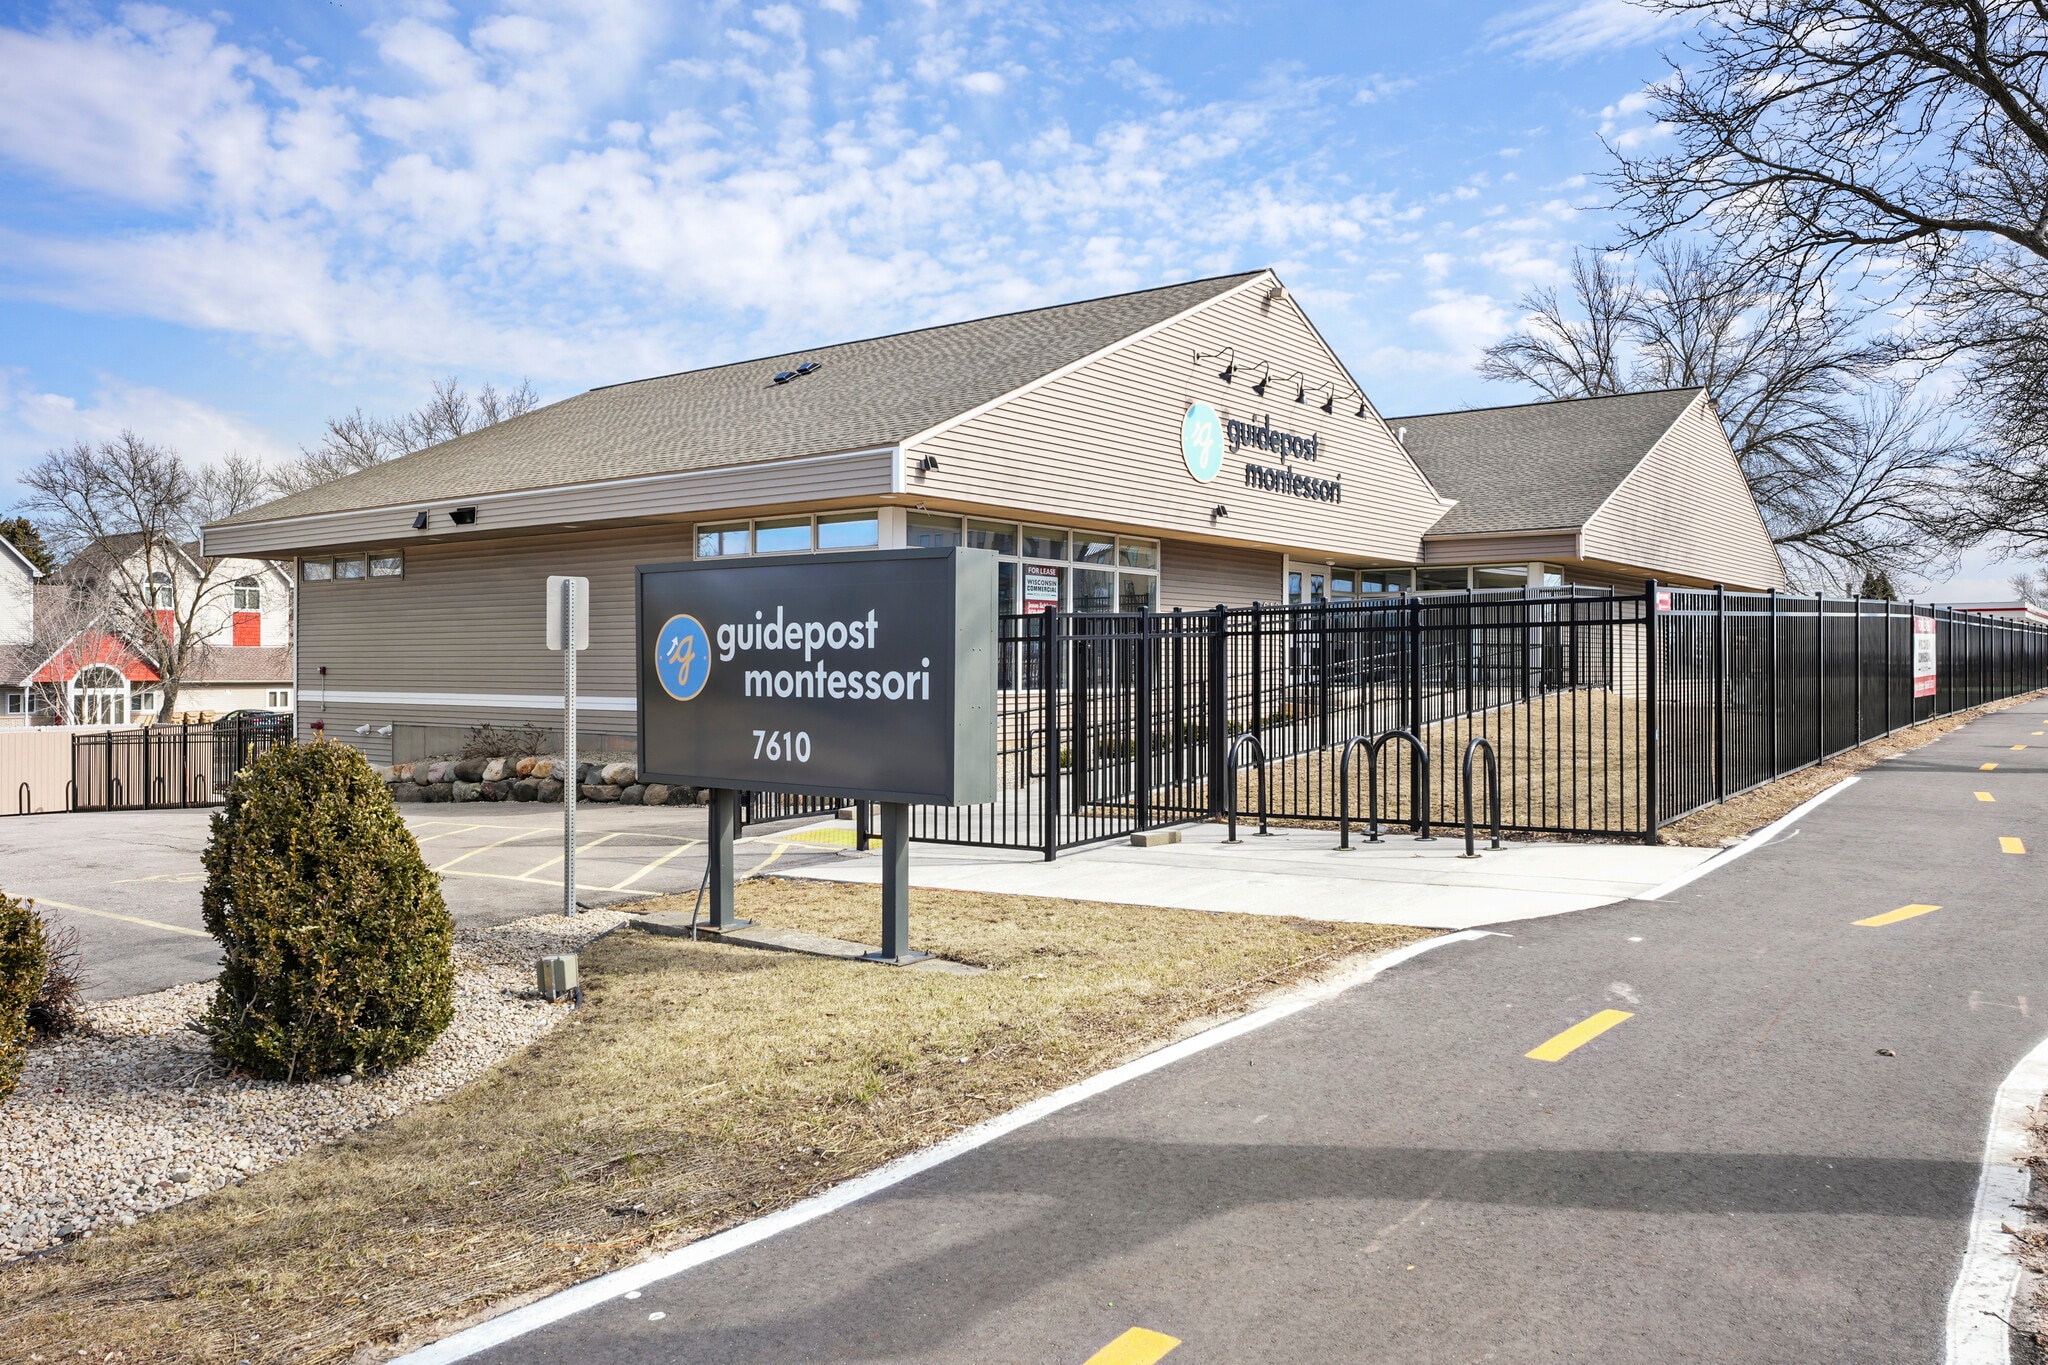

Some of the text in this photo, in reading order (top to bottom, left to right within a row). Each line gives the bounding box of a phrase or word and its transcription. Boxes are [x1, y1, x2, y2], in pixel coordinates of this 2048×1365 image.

[1227, 414, 1319, 464] guidepost
[1245, 463, 1342, 504] montessori
[1027, 585, 1056, 593] COMMERCIAL
[716, 606, 879, 662] guidepost
[744, 656, 930, 700] montessori
[752, 730, 811, 763] 7610
